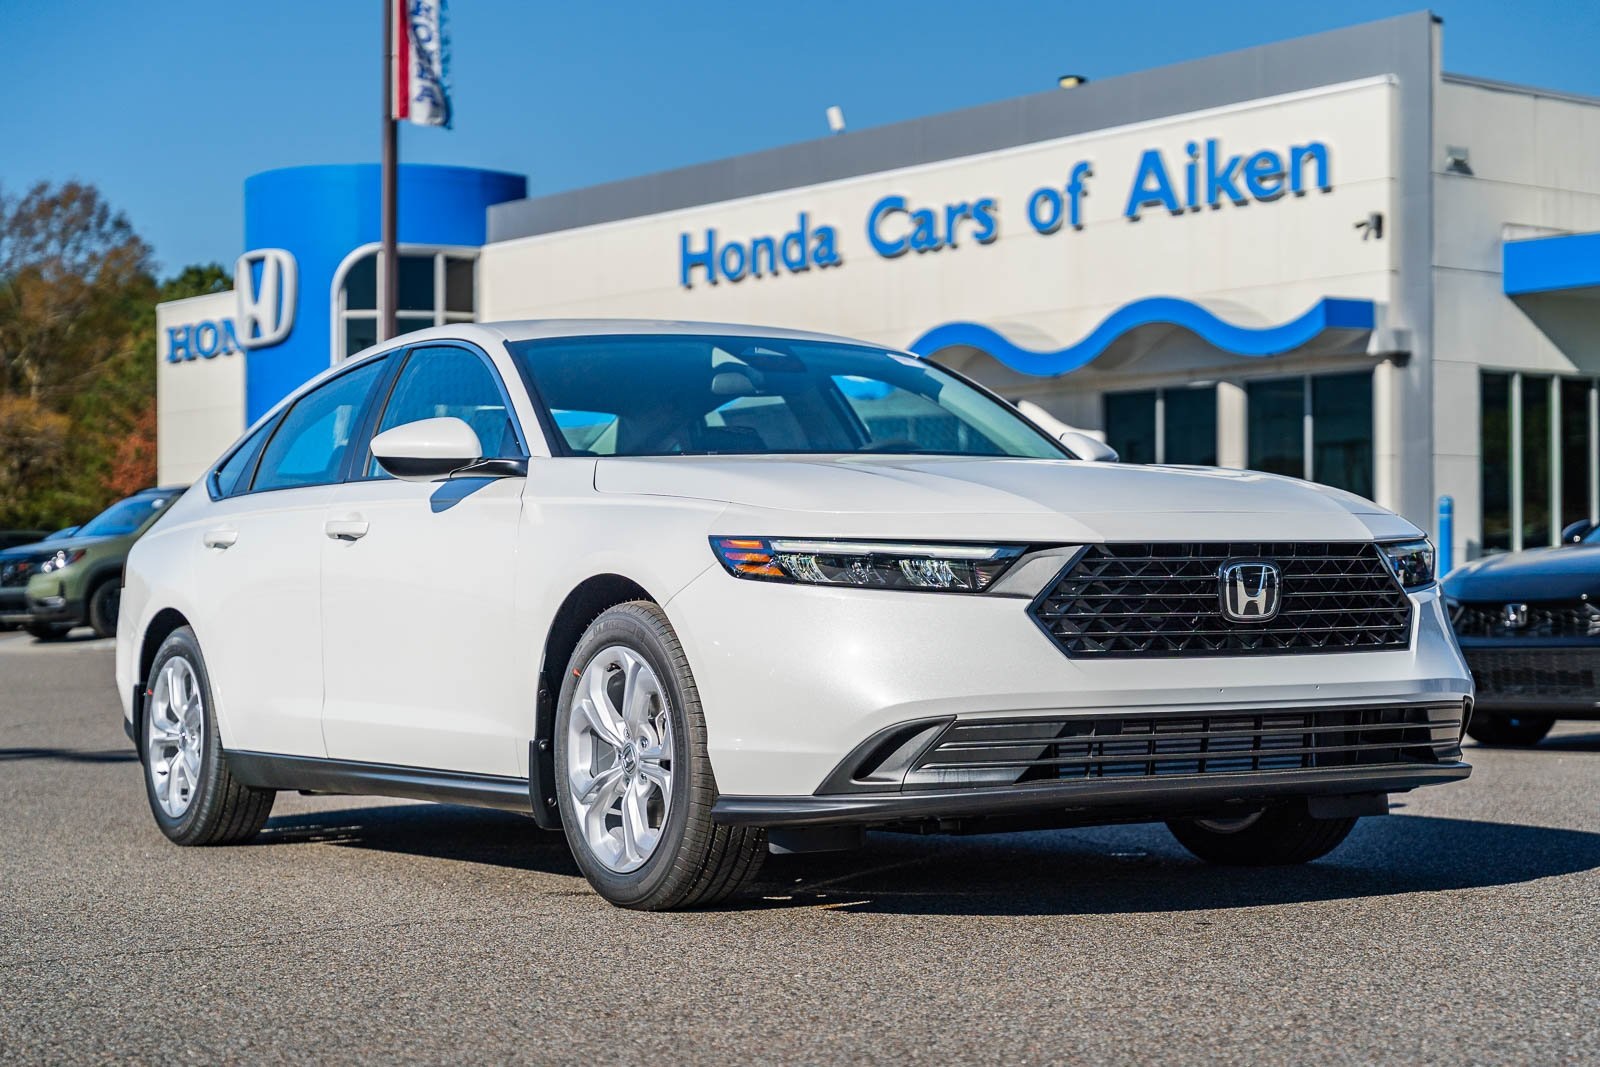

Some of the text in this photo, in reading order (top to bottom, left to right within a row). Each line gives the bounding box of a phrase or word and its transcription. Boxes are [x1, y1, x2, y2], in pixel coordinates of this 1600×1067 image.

[680, 138, 1331, 287] Honda Cars of Aiken
